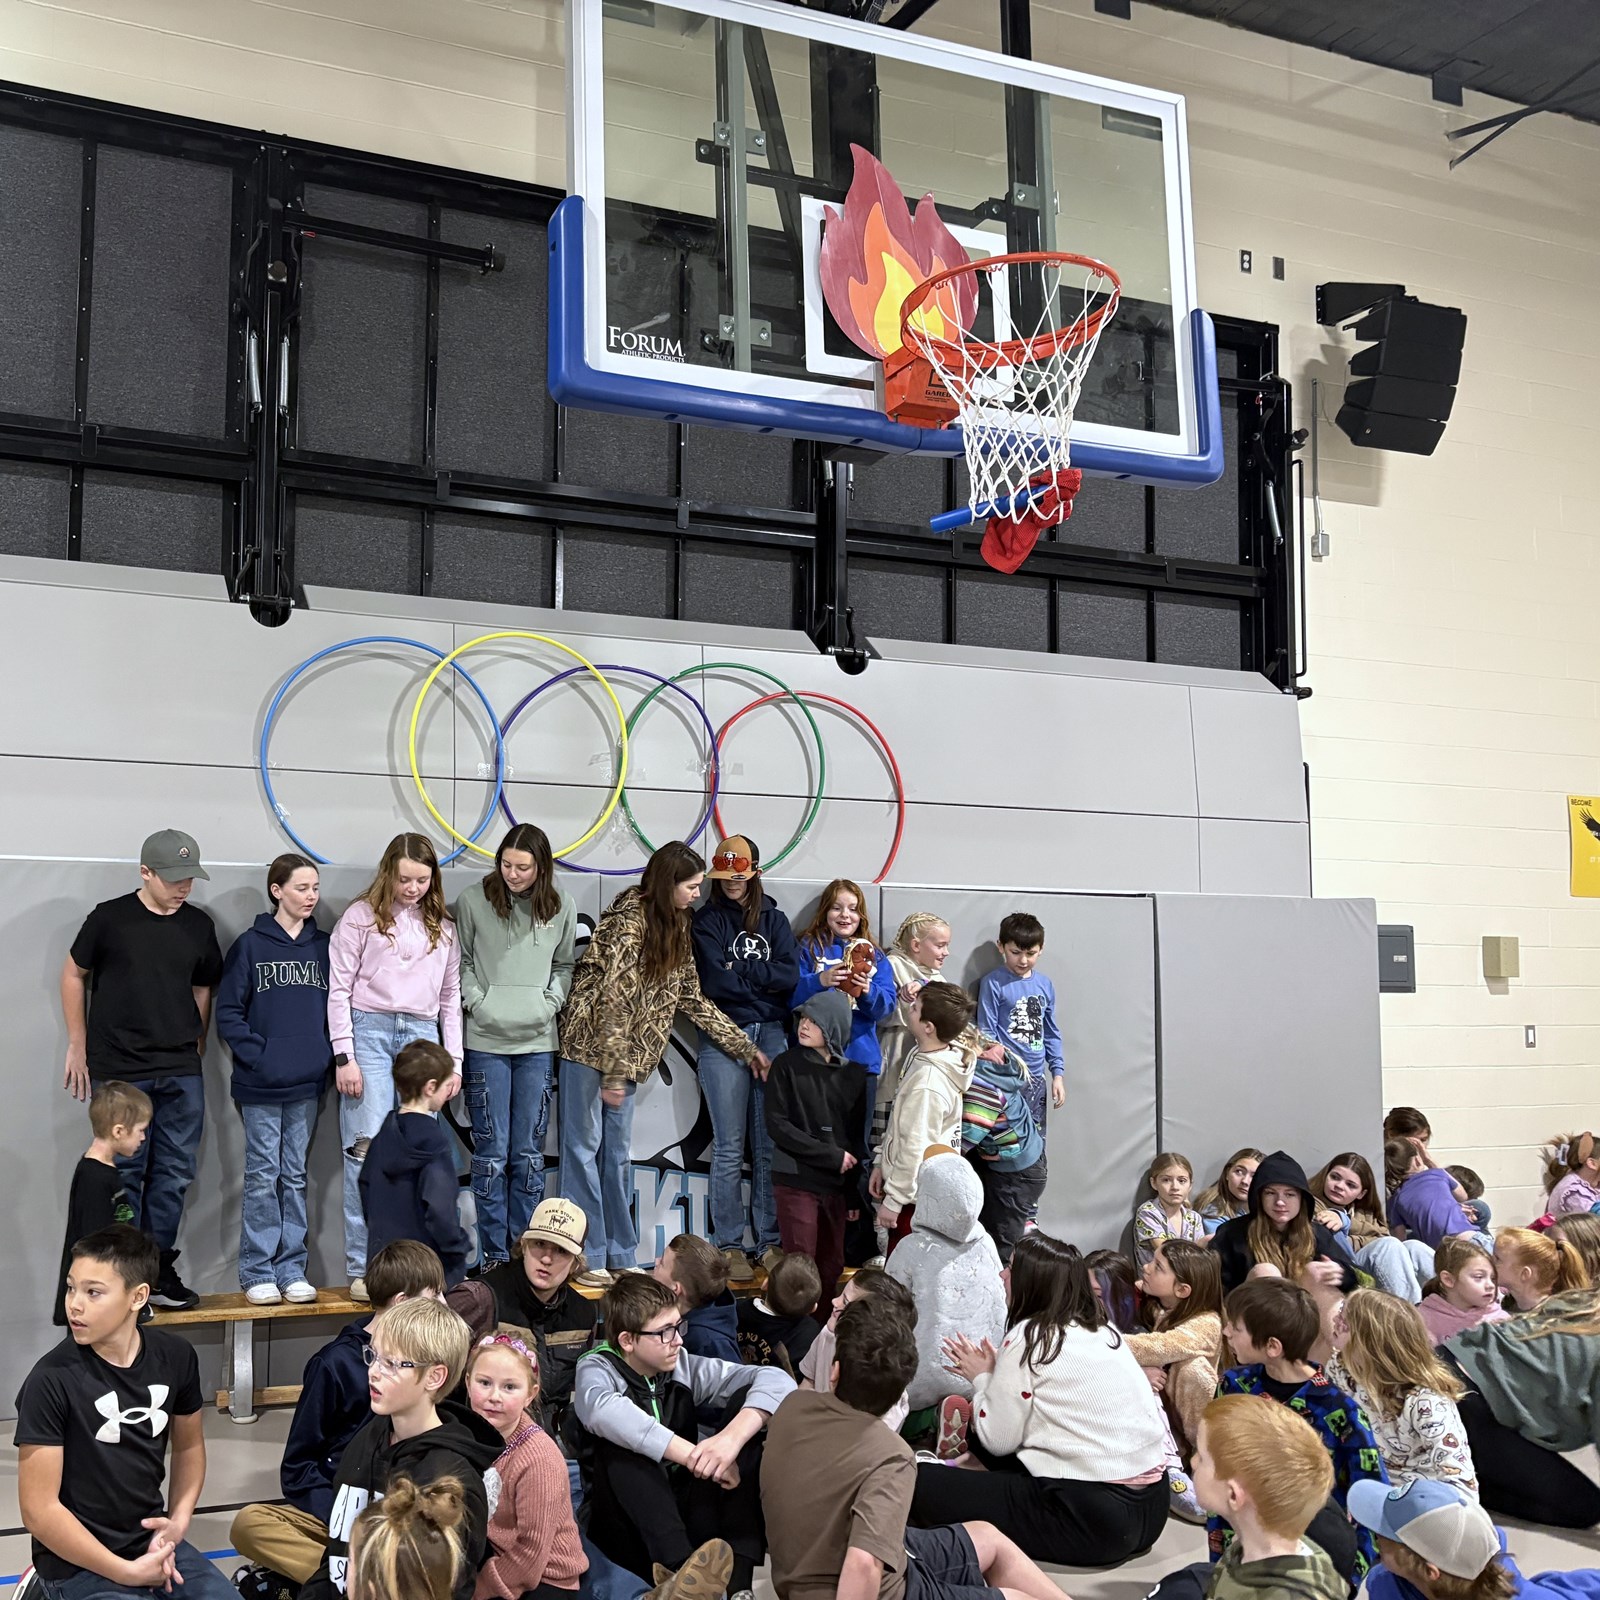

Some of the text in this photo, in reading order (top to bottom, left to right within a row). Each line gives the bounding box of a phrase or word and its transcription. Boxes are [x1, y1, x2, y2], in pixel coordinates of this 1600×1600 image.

[621, 349, 685, 363] ATHLETIC PRODUCTS
[256, 961, 328, 993] PUMA
